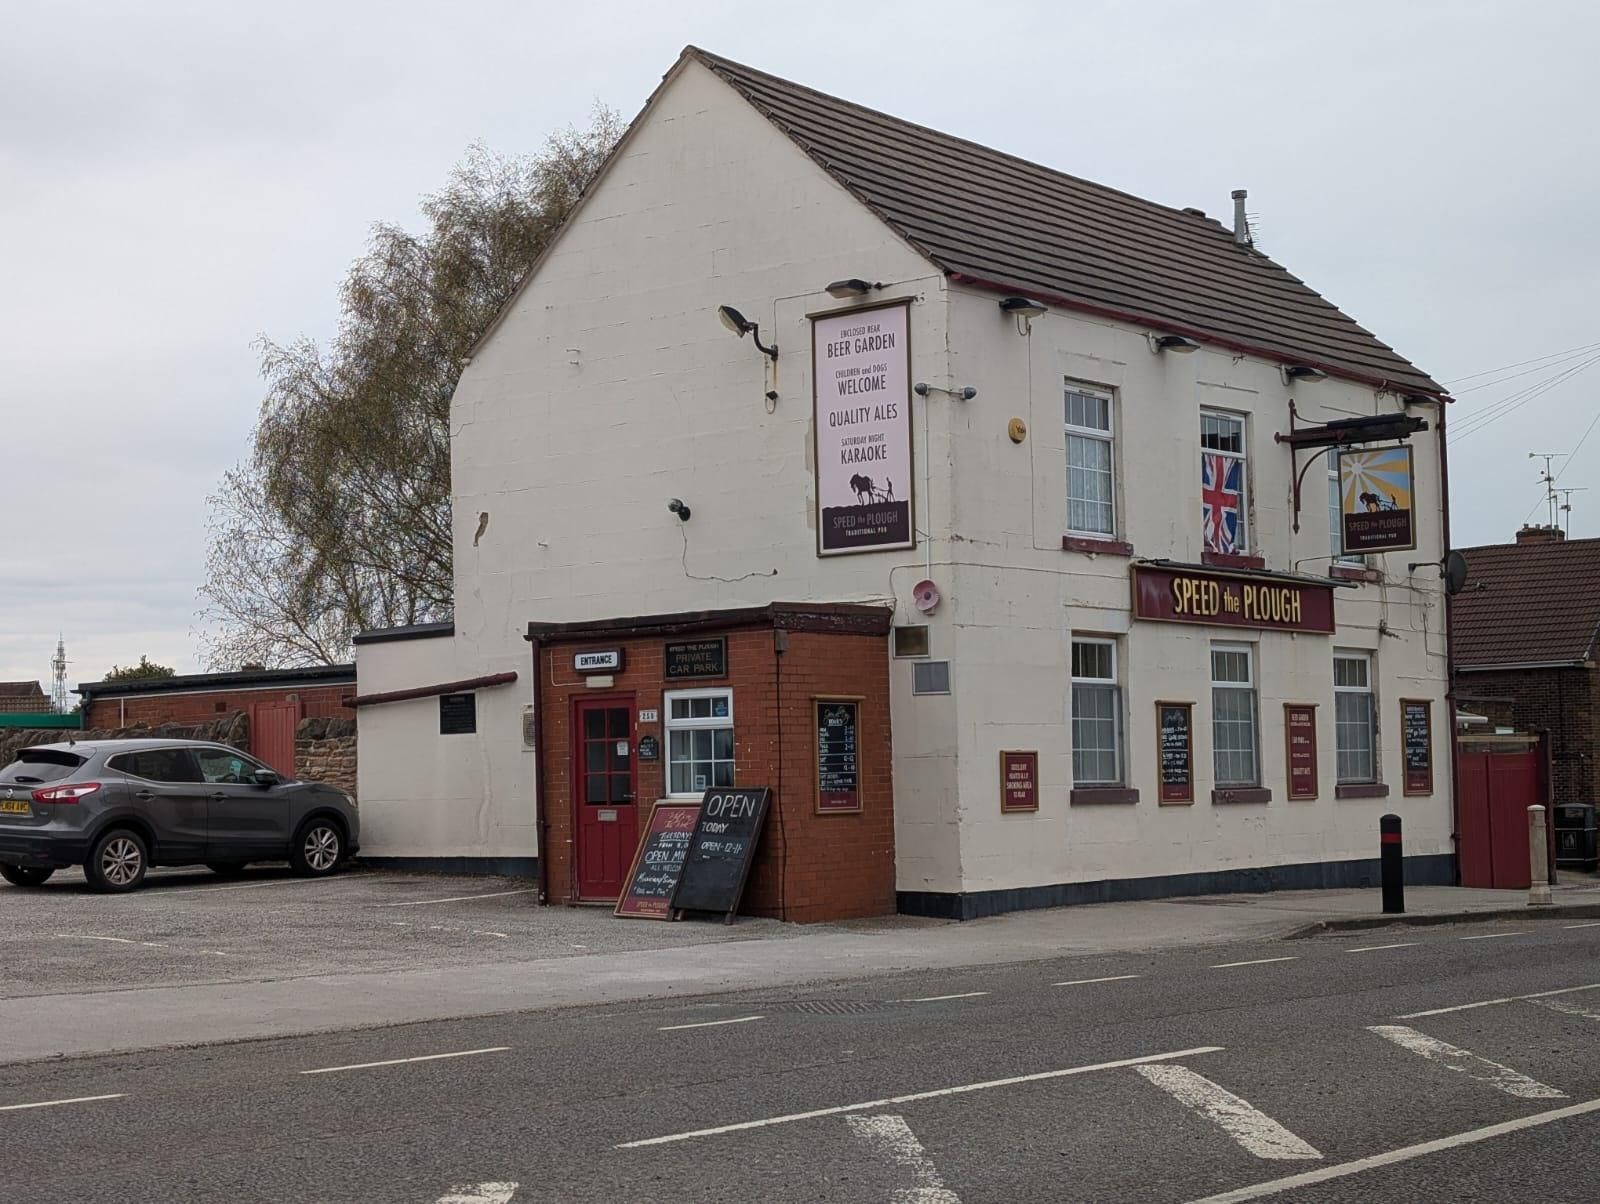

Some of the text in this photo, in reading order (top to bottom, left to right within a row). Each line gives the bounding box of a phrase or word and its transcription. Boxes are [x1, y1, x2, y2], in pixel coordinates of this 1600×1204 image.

[840, 324, 881, 339] ENCLOSED REAR
[827, 332, 896, 358] BEER GARDEN
[835, 363, 888, 379] CHILDREN and DOGS
[837, 374, 887, 396] WELCOME
[829, 403, 898, 427] QUALITY ALES
[841, 433, 885, 447] SATURDAY NIGHT
[840, 444, 887, 465] KARAOKE
[833, 515, 856, 529] SPEED
[866, 511, 898, 526] PLOUGH
[1349, 520, 1370, 531] SPEED
[1378, 518, 1407, 529] PLOUGH
[845, 527, 876, 537] TRADITIONAL
[1173, 577, 1301, 622] SPEED the PLOUGH
[580, 654, 612, 666] ENTRANCE
[676, 652, 712, 664] PRIVATE
[669, 663, 718, 674] CAR PARK
[707, 794, 756, 818] OPEN
[702, 822, 729, 834] TODAY
[645, 850, 670, 862] OPEN
